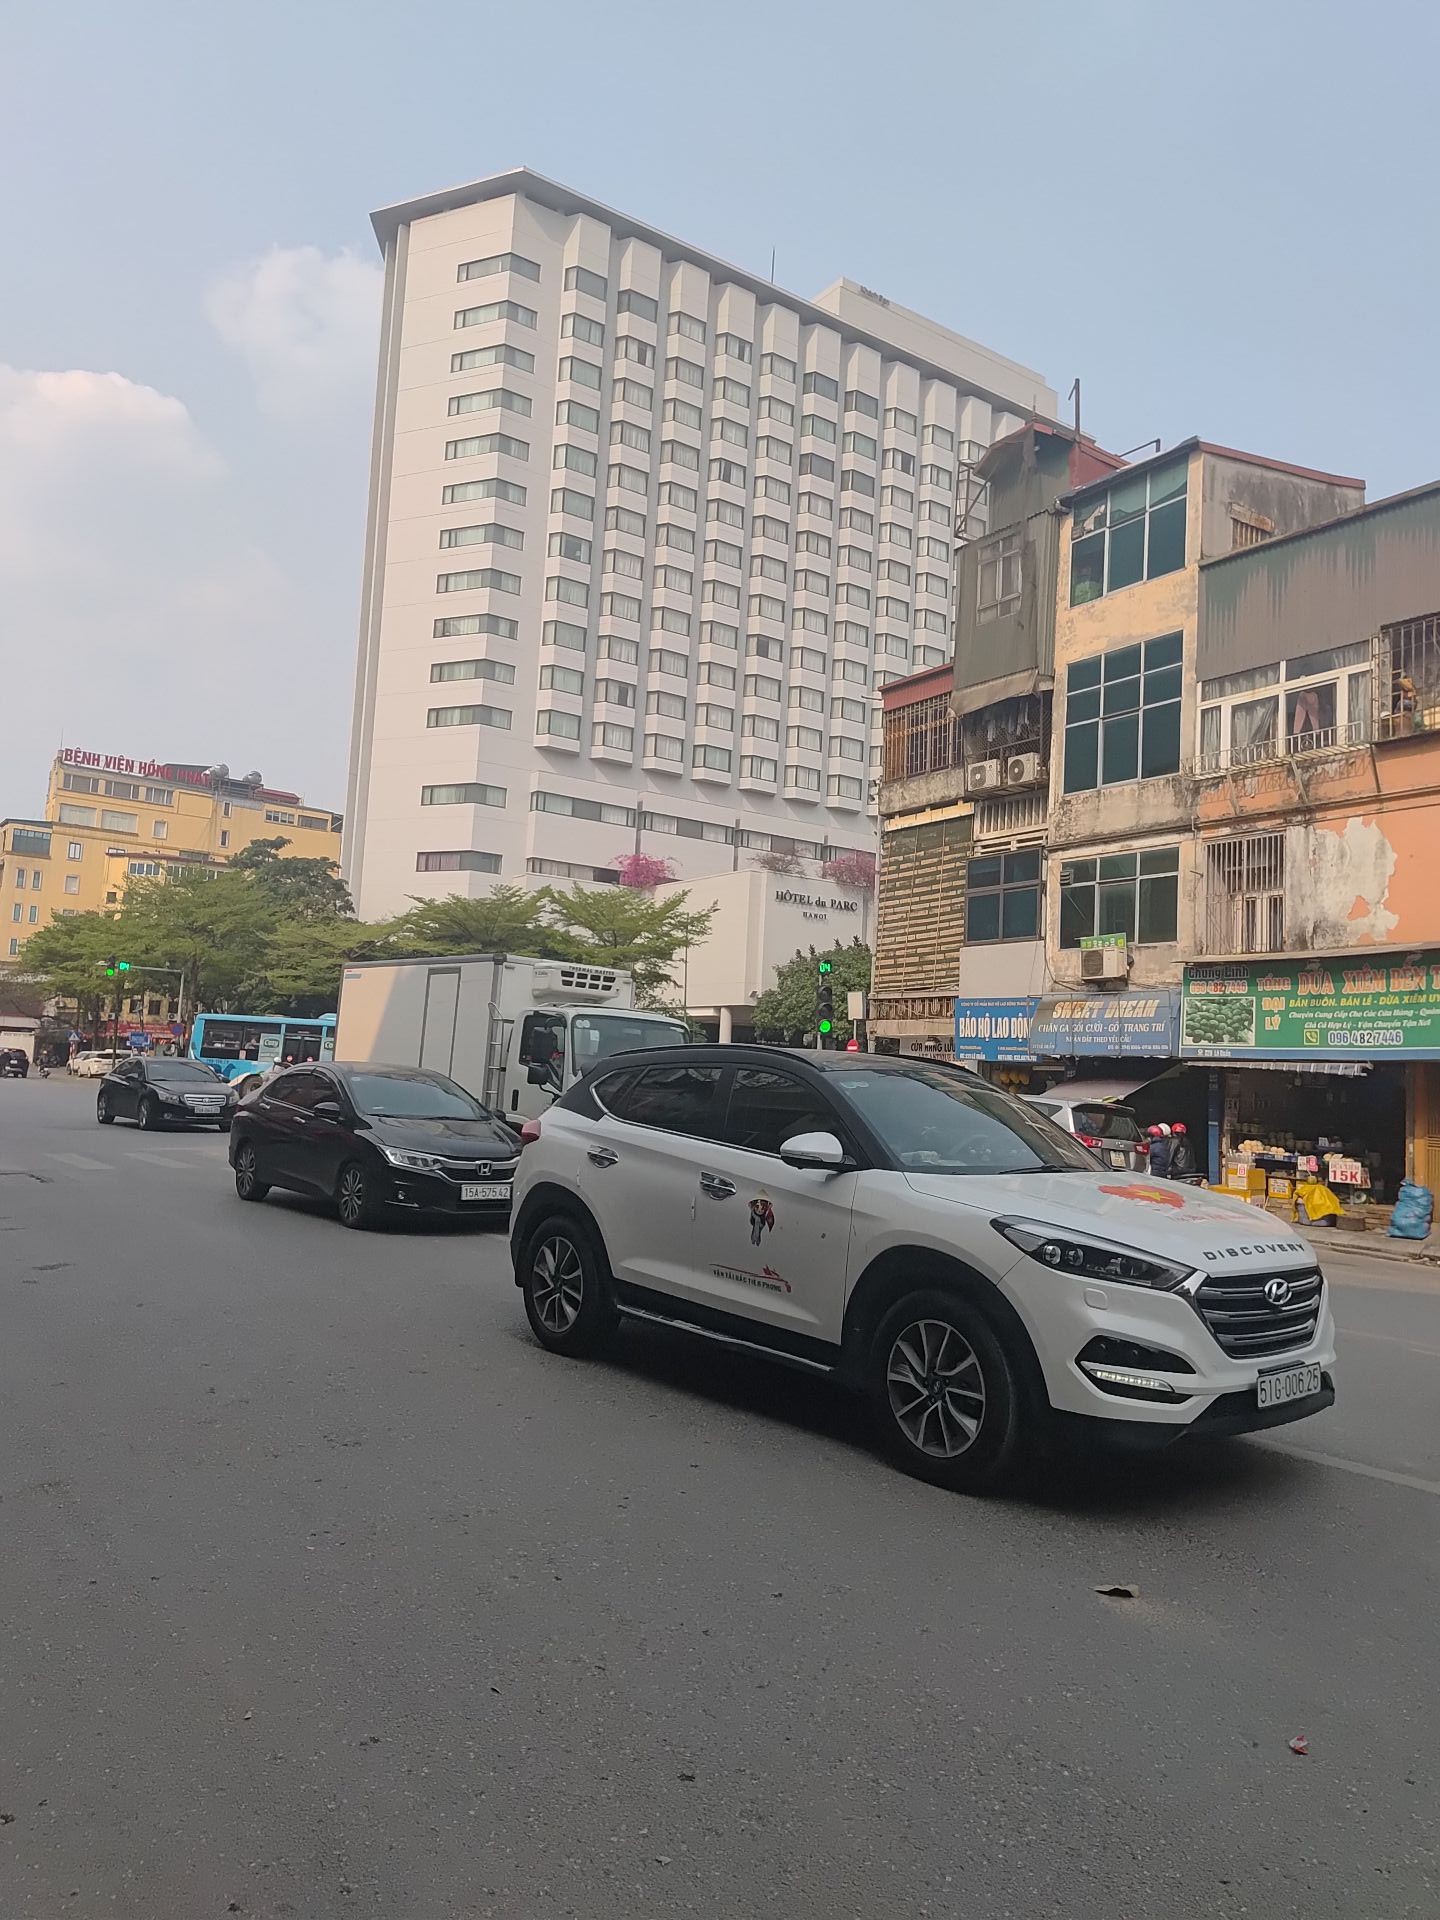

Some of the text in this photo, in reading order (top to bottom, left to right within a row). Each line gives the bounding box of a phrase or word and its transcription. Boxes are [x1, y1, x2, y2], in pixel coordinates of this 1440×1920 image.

[64, 747, 101, 768] BỆNH
[104, 755, 135, 774] VIỆN
[775, 889, 814, 905] HÔTEL
[830, 898, 858, 912] PARC
[802, 911, 828, 920] HANOI
[569, 965, 593, 974] THERMAL
[1342, 963, 1387, 994] XIÊM
[1052, 1000, 1160, 1019] SWEET DREAM
[959, 1010, 977, 1038] BẢO
[977, 1012, 990, 1041] HỘ
[992, 1016, 1009, 1039] LAO
[1060, 1024, 1069, 1032] GA
[1123, 1023, 1150, 1032] TRANG
[1151, 1020, 1166, 1032] TRÍ
[1265, 1014, 1281, 1031] LÝ
[1329, 1030, 1403, 1046] 096 482 7446
[1330, 1170, 1359, 1183] 15K
[464, 1187, 509, 1199] 15A-575.42
[1203, 1242, 1306, 1261] DISCOVERY
[1258, 1367, 1320, 1404] 51G-006.25
